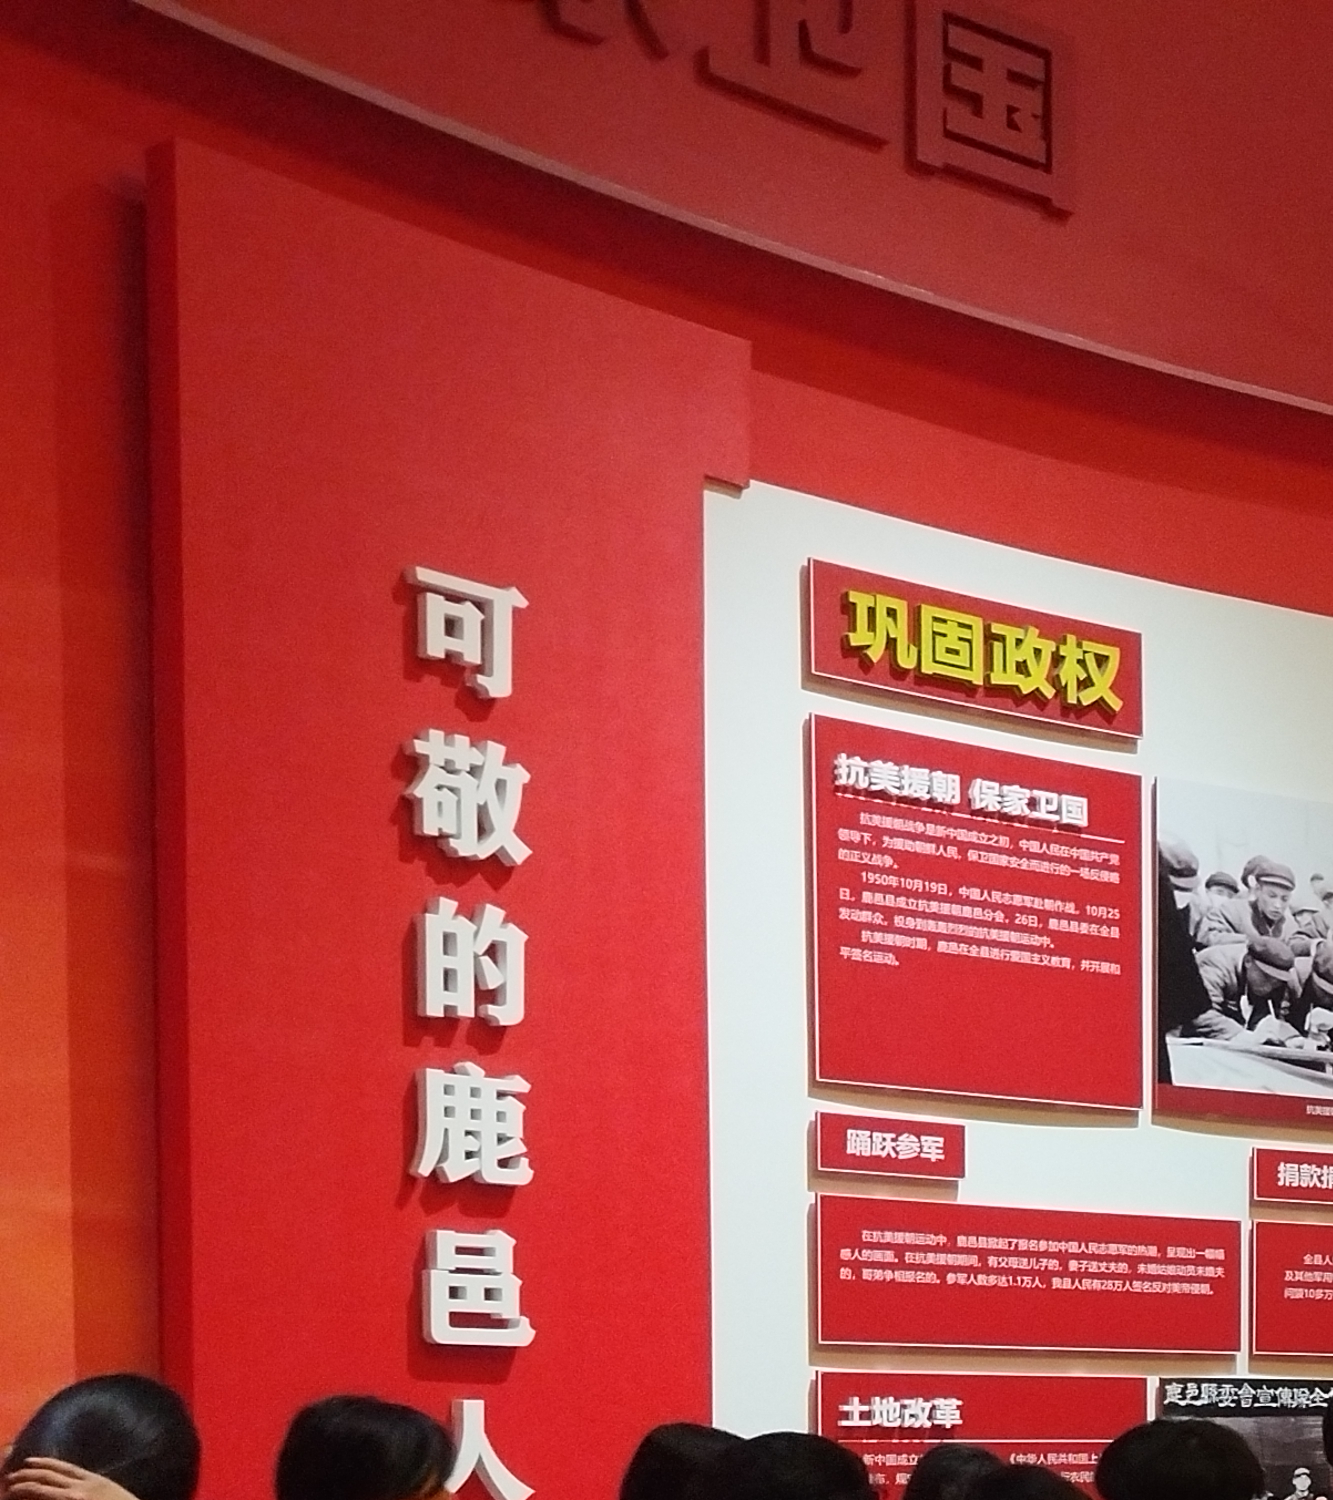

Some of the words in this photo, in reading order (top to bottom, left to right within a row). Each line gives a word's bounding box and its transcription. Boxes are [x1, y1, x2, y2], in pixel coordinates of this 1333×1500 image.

[841, 590, 1123, 714] 巩固政权
[834, 753, 961, 805] 抗美援朝
[968, 778, 1089, 829] 保家卫国
[846, 1128, 945, 1162] 踊跃参军
[838, 1396, 963, 1429] 土地改革
